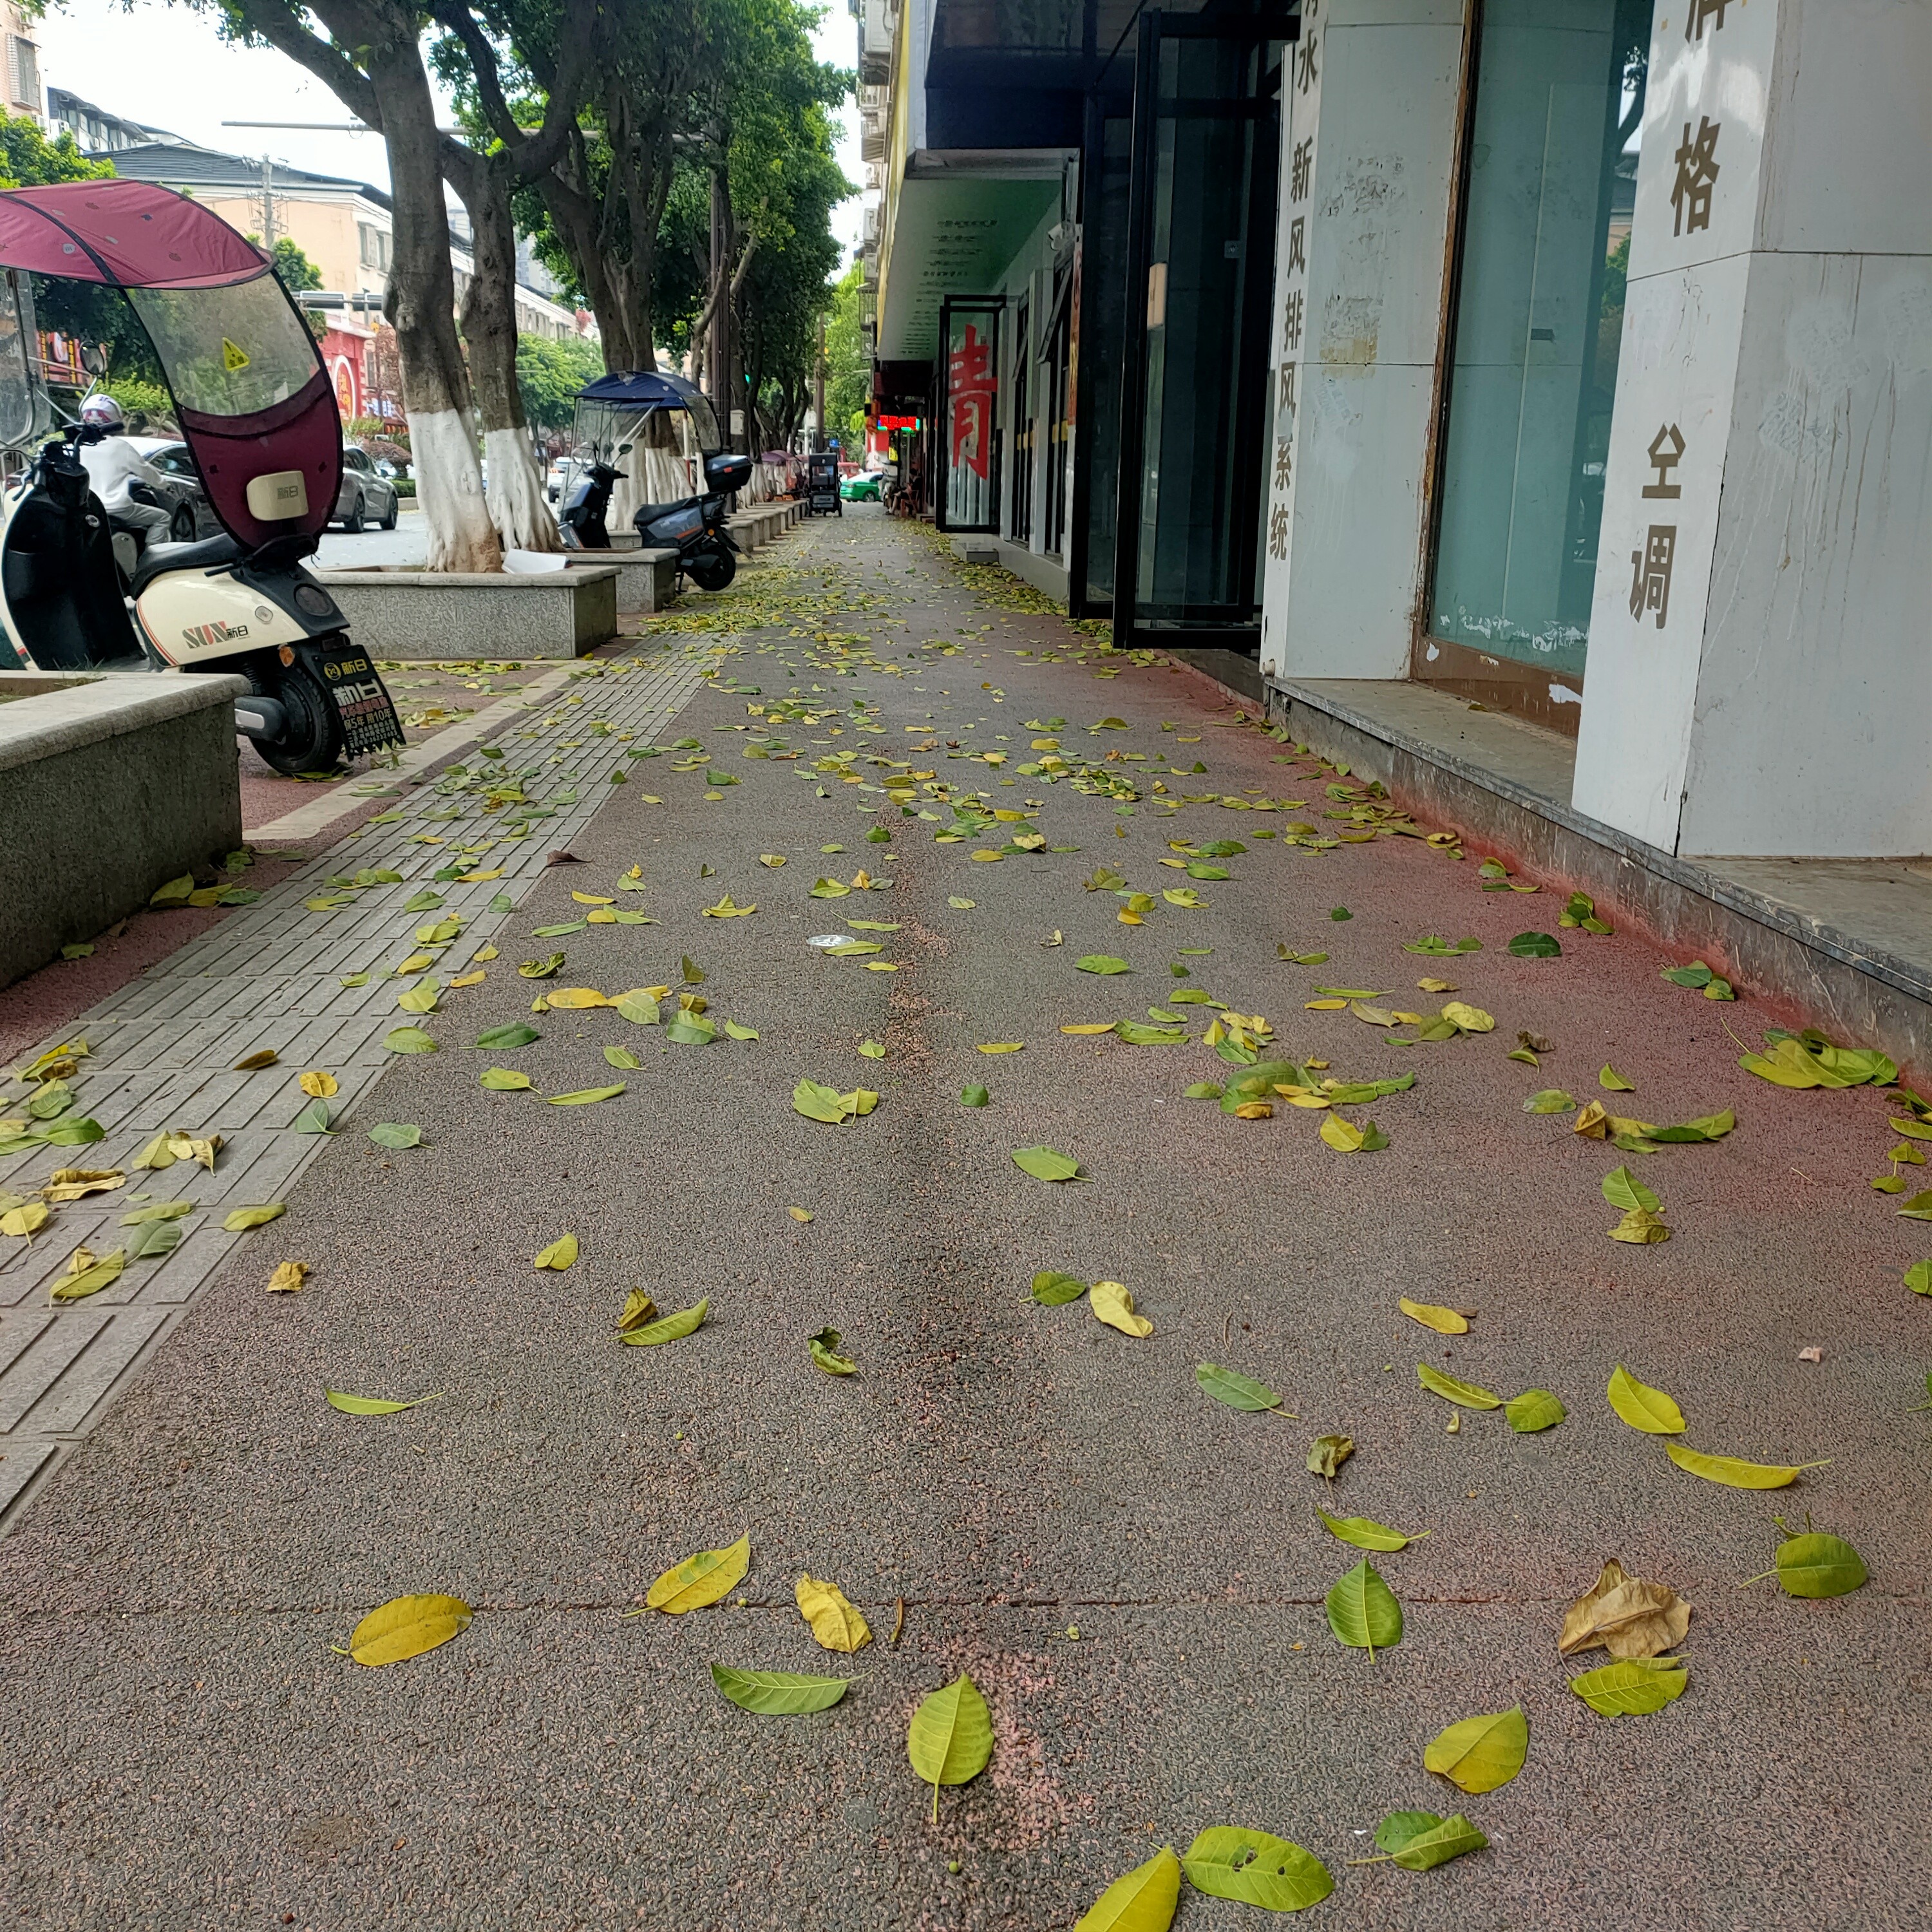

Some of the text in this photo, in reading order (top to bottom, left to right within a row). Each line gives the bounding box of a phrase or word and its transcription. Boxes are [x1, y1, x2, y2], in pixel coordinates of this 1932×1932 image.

[1270, 135, 1313, 560] 新风排风系统
[182, 621, 249, 649] SUN 新日
[341, 659, 368, 675] 新日
